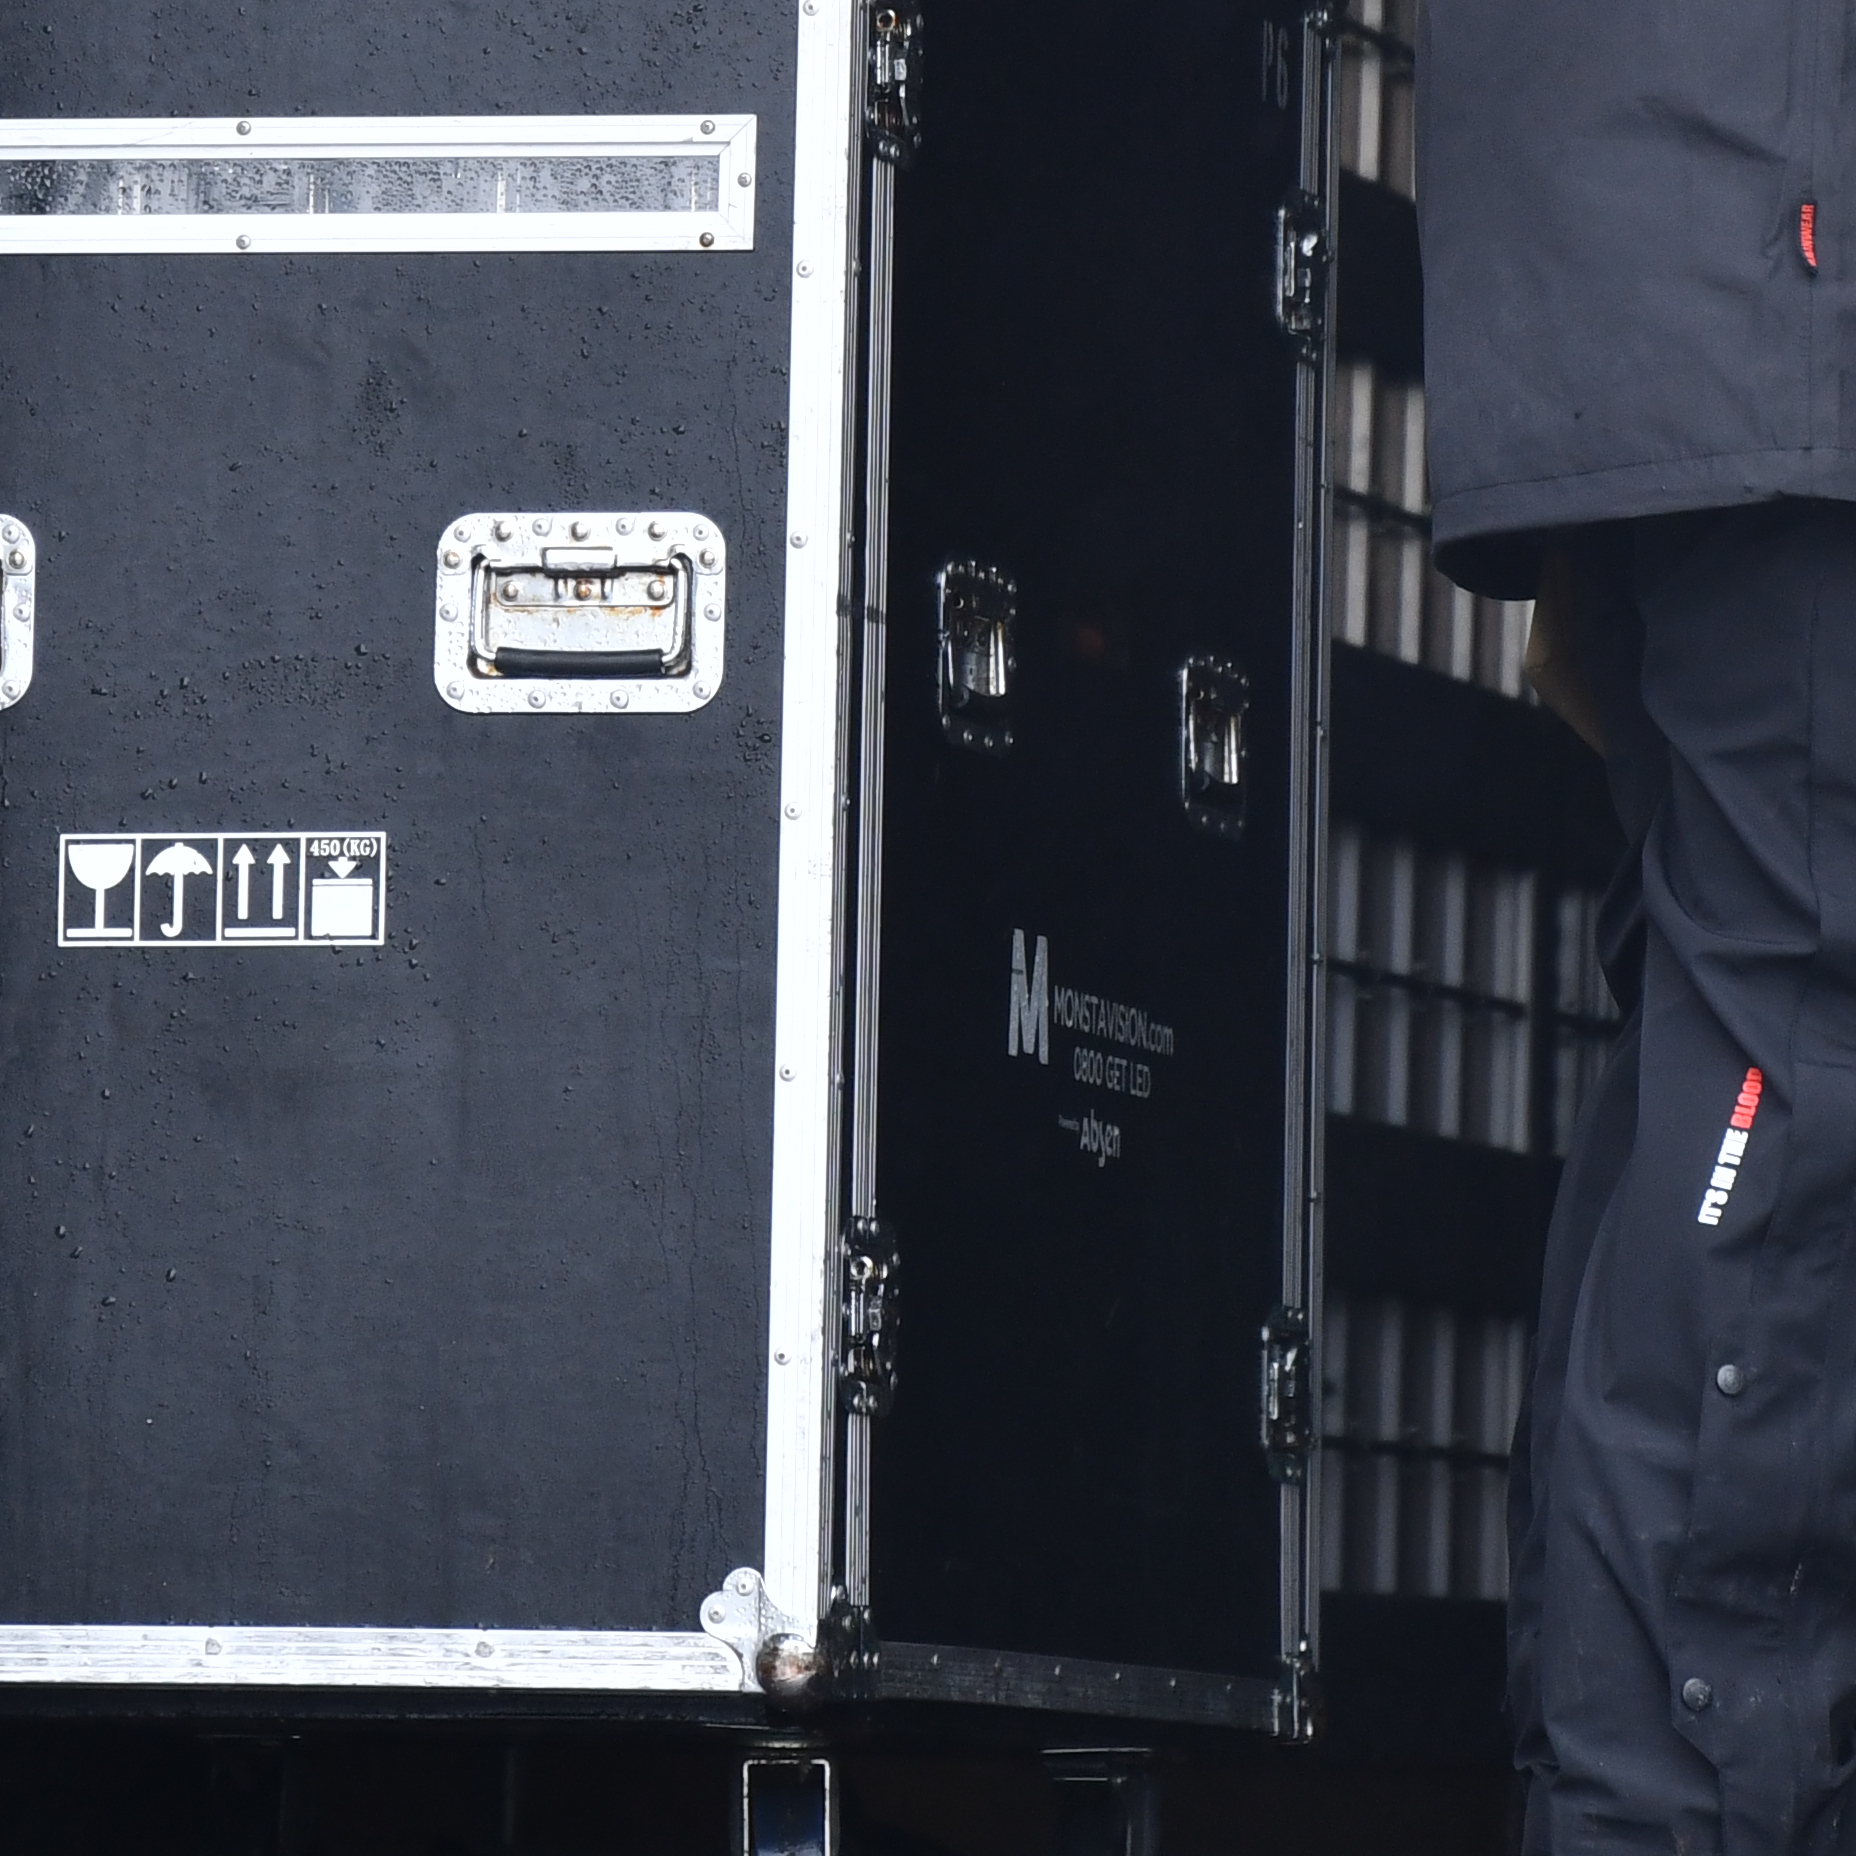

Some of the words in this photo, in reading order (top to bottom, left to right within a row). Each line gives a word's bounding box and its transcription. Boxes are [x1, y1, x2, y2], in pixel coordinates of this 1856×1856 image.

[309, 837, 378, 858] 450(KG)
[1007, 928, 1050, 1065] M
[1053, 984, 1175, 1056] MONSTAVISION.com
[1073, 1046, 1104, 1087] 0800
[1105, 1055, 1128, 1093] GET
[1129, 1062, 1152, 1099] LED
[1730, 1066, 1763, 1129] BLOOD
[1717, 1127, 1749, 1166] THE
